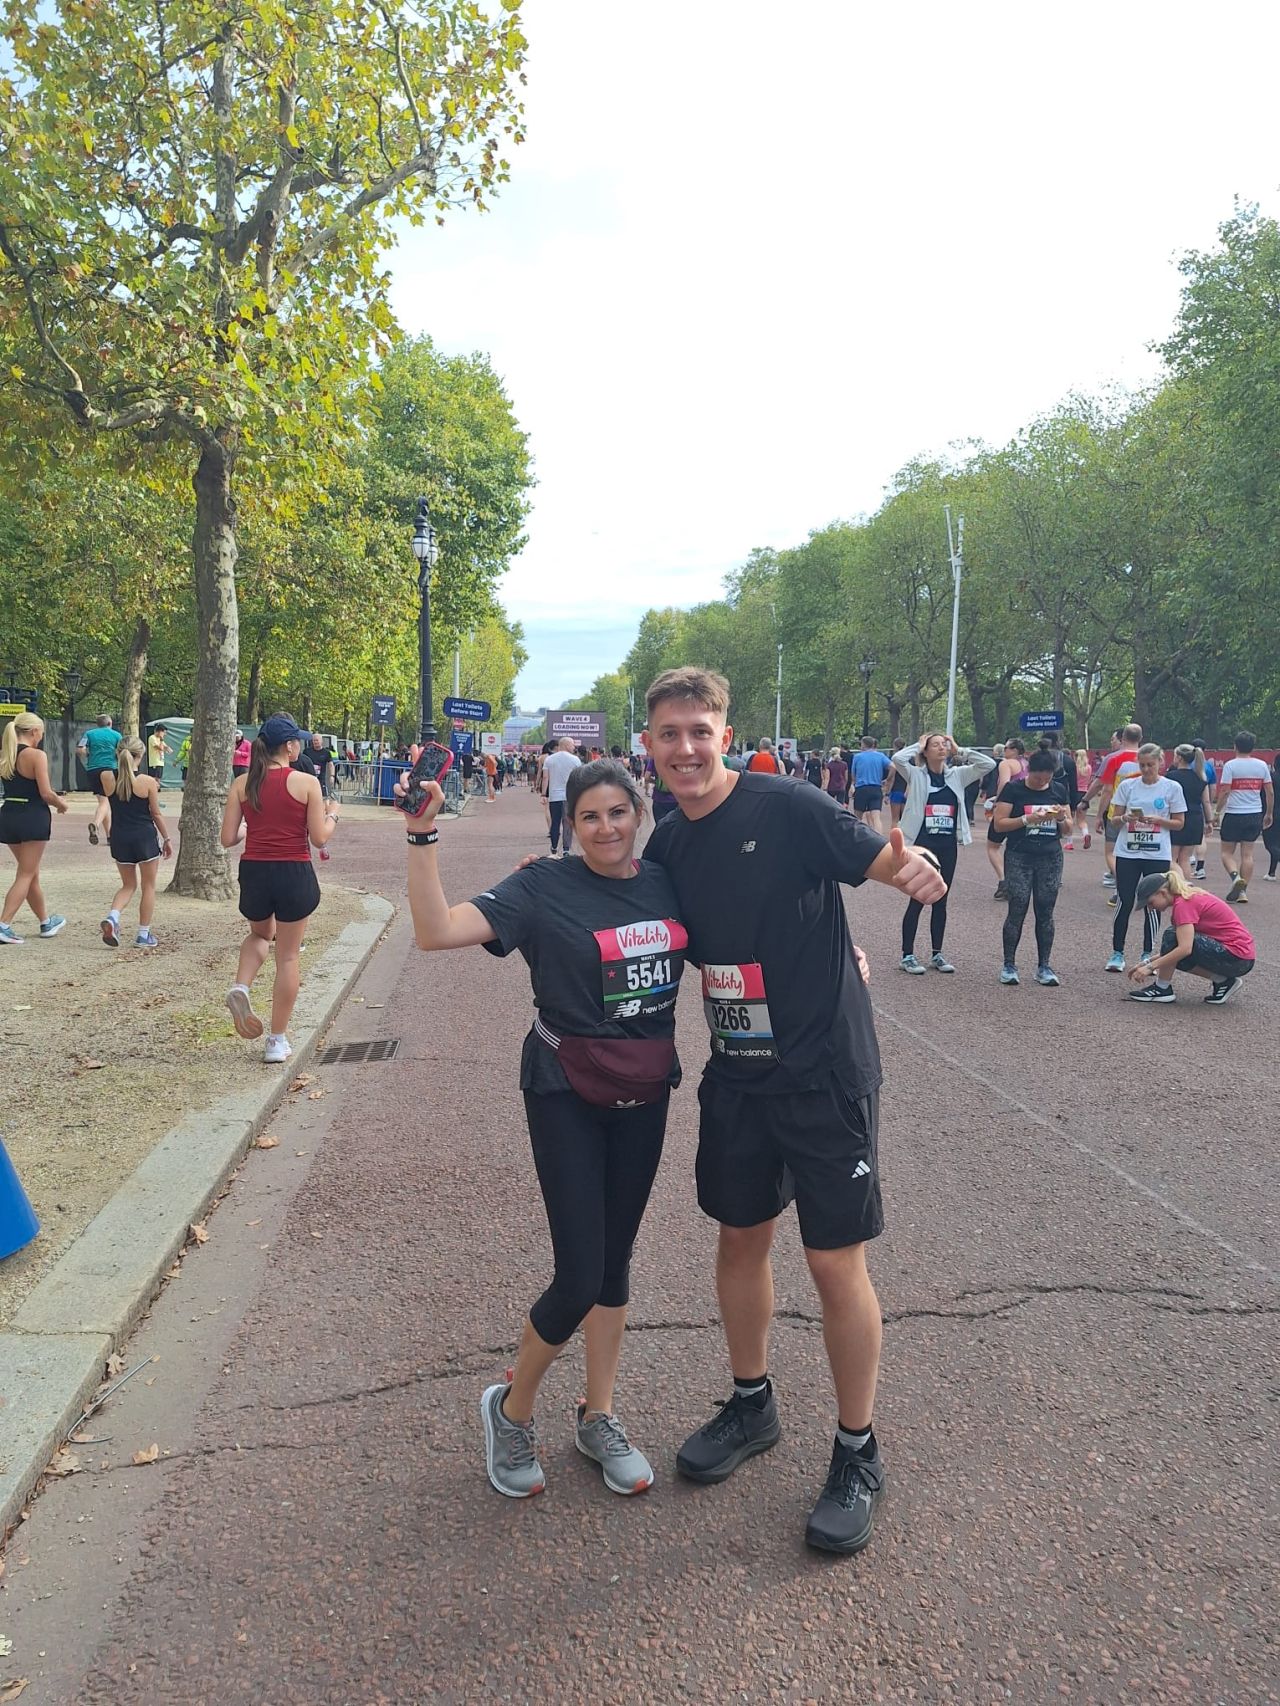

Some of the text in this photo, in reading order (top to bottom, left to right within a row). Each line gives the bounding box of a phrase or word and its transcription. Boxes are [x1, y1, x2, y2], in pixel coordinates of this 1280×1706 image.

[450, 707, 469, 715] Before
[1134, 833, 1154, 842] 14214
[619, 926, 668, 949] Vitality
[627, 959, 671, 991] 5541
[705, 967, 742, 997] Vitality
[642, 1005, 658, 1014] new
